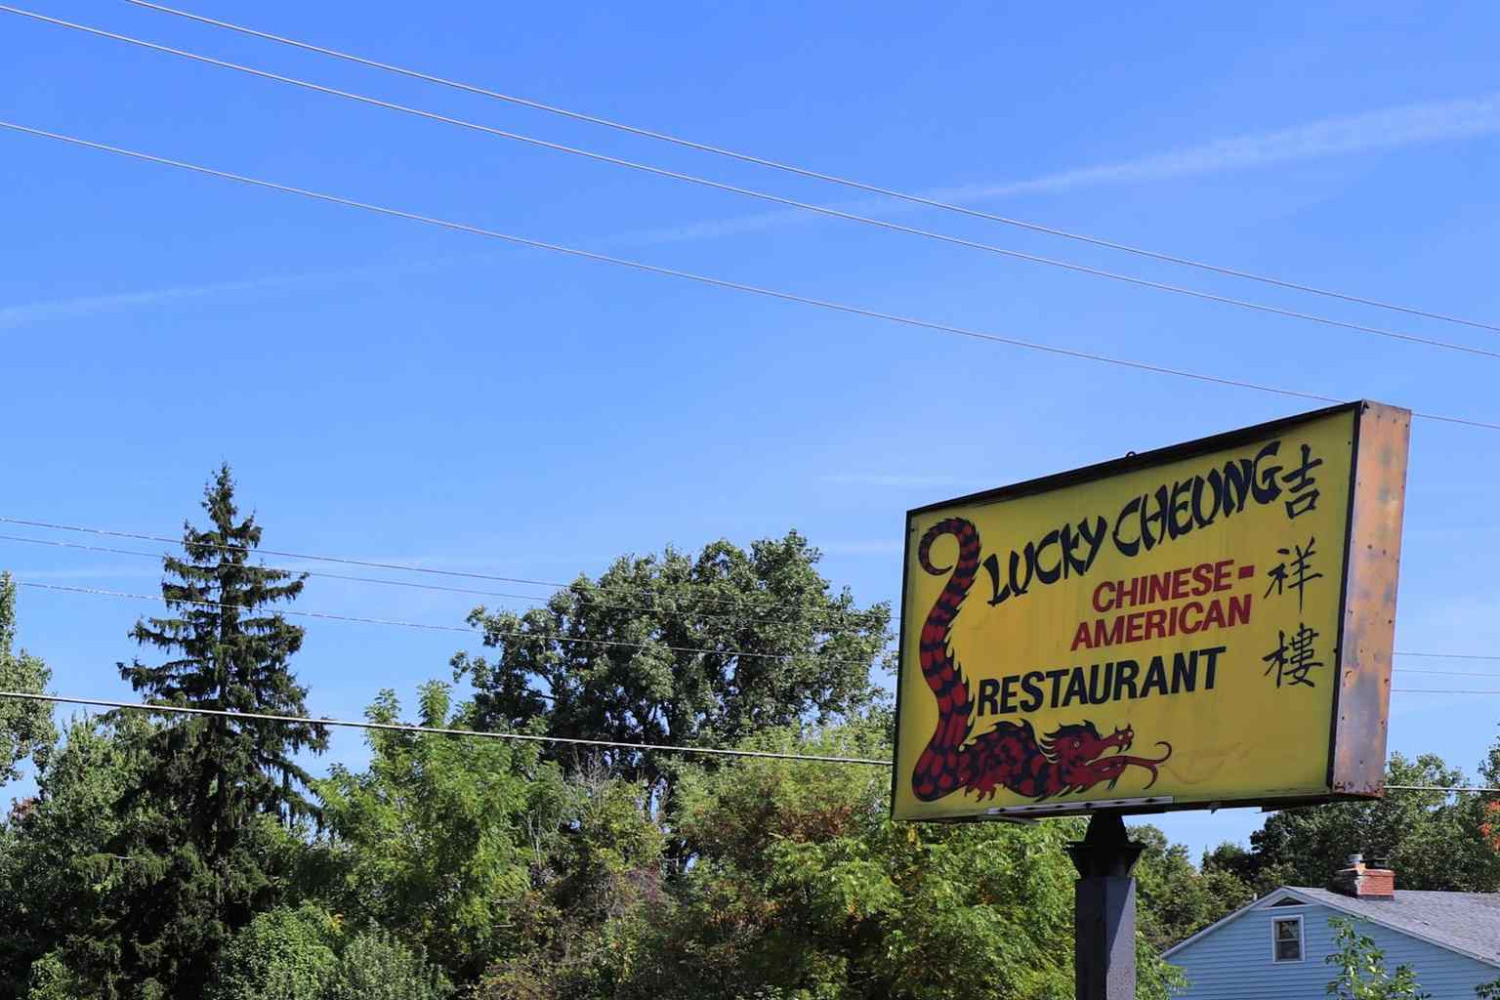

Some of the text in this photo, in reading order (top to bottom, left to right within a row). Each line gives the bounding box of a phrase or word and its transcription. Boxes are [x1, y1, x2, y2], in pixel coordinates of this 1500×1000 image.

[982, 440, 1284, 607] LUCKY CHEUNG
[1262, 444, 1324, 689] 吉祥樓
[976, 646, 1227, 718] RESTAURANT
[1070, 593, 1252, 652] AMERICAN
